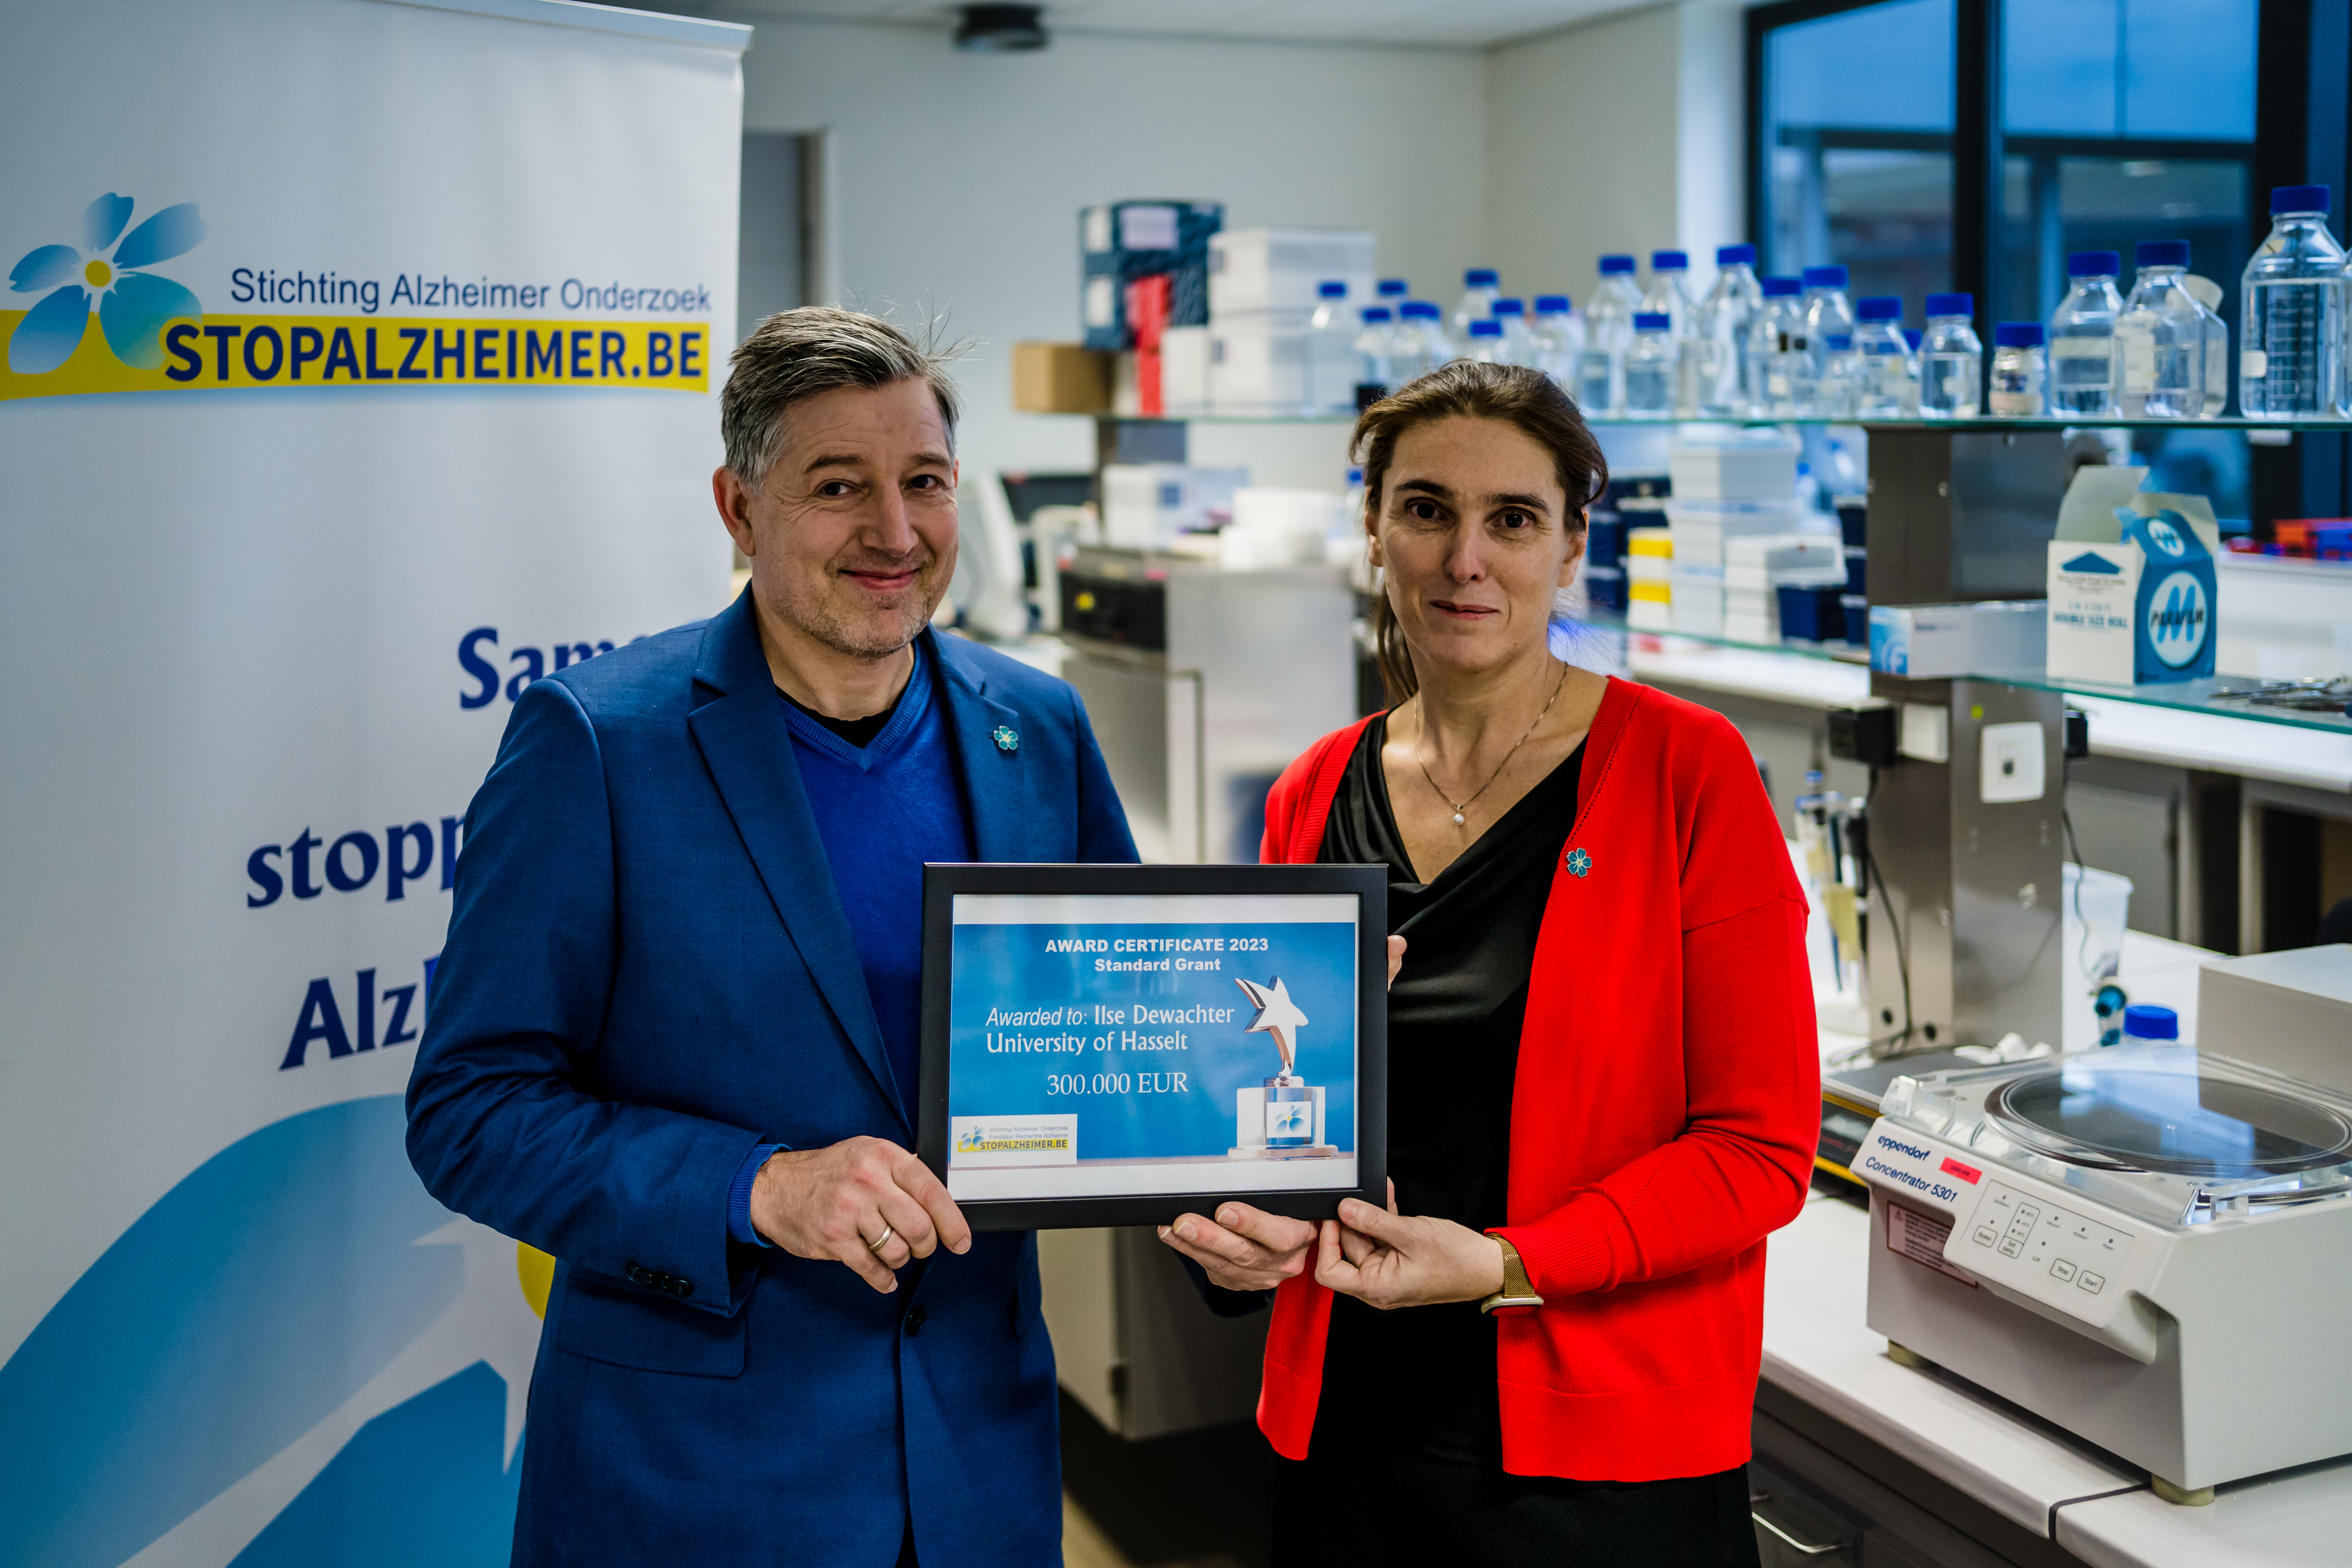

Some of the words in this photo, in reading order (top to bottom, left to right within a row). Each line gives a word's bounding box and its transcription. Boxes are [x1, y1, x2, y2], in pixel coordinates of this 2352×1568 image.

[231, 267, 379, 314] Stichting
[390, 273, 550, 308] Alzheimer
[561, 278, 710, 312] Onderzoek
[165, 323, 701, 383] STOPALZHEIMER.BE
[457, 626, 649, 710] Sa
[1045, 939, 1108, 953] AWARD
[1113, 938, 1224, 952] CERTIFICATE
[1229, 938, 1268, 951] 2023
[1095, 958, 1170, 972] Standard
[1175, 958, 1221, 971] Grant
[278, 953, 440, 1072] Alz
[985, 1006, 1062, 1026] Awarded
[1067, 1007, 1087, 1025] to:
[1095, 1005, 1125, 1025] Ilse
[1133, 1004, 1235, 1024] Dewachter
[987, 1032, 1087, 1056] University
[1093, 1031, 1115, 1051] of
[1122, 1030, 1188, 1051] Hasselt
[1047, 1073, 1131, 1095] 300.000
[1137, 1071, 1189, 1094] EUR
[980, 1140, 1067, 1149] STOPALZHEIMER.BE
[1878, 1135, 1930, 1161] eppendorf
[1865, 1156, 1931, 1191] Concentrator
[1930, 1184, 1957, 1202] 5301
[2003, 1246, 2014, 1254] temp
[2057, 1266, 2069, 1275] Stop
[2084, 1277, 2097, 1287] Start
